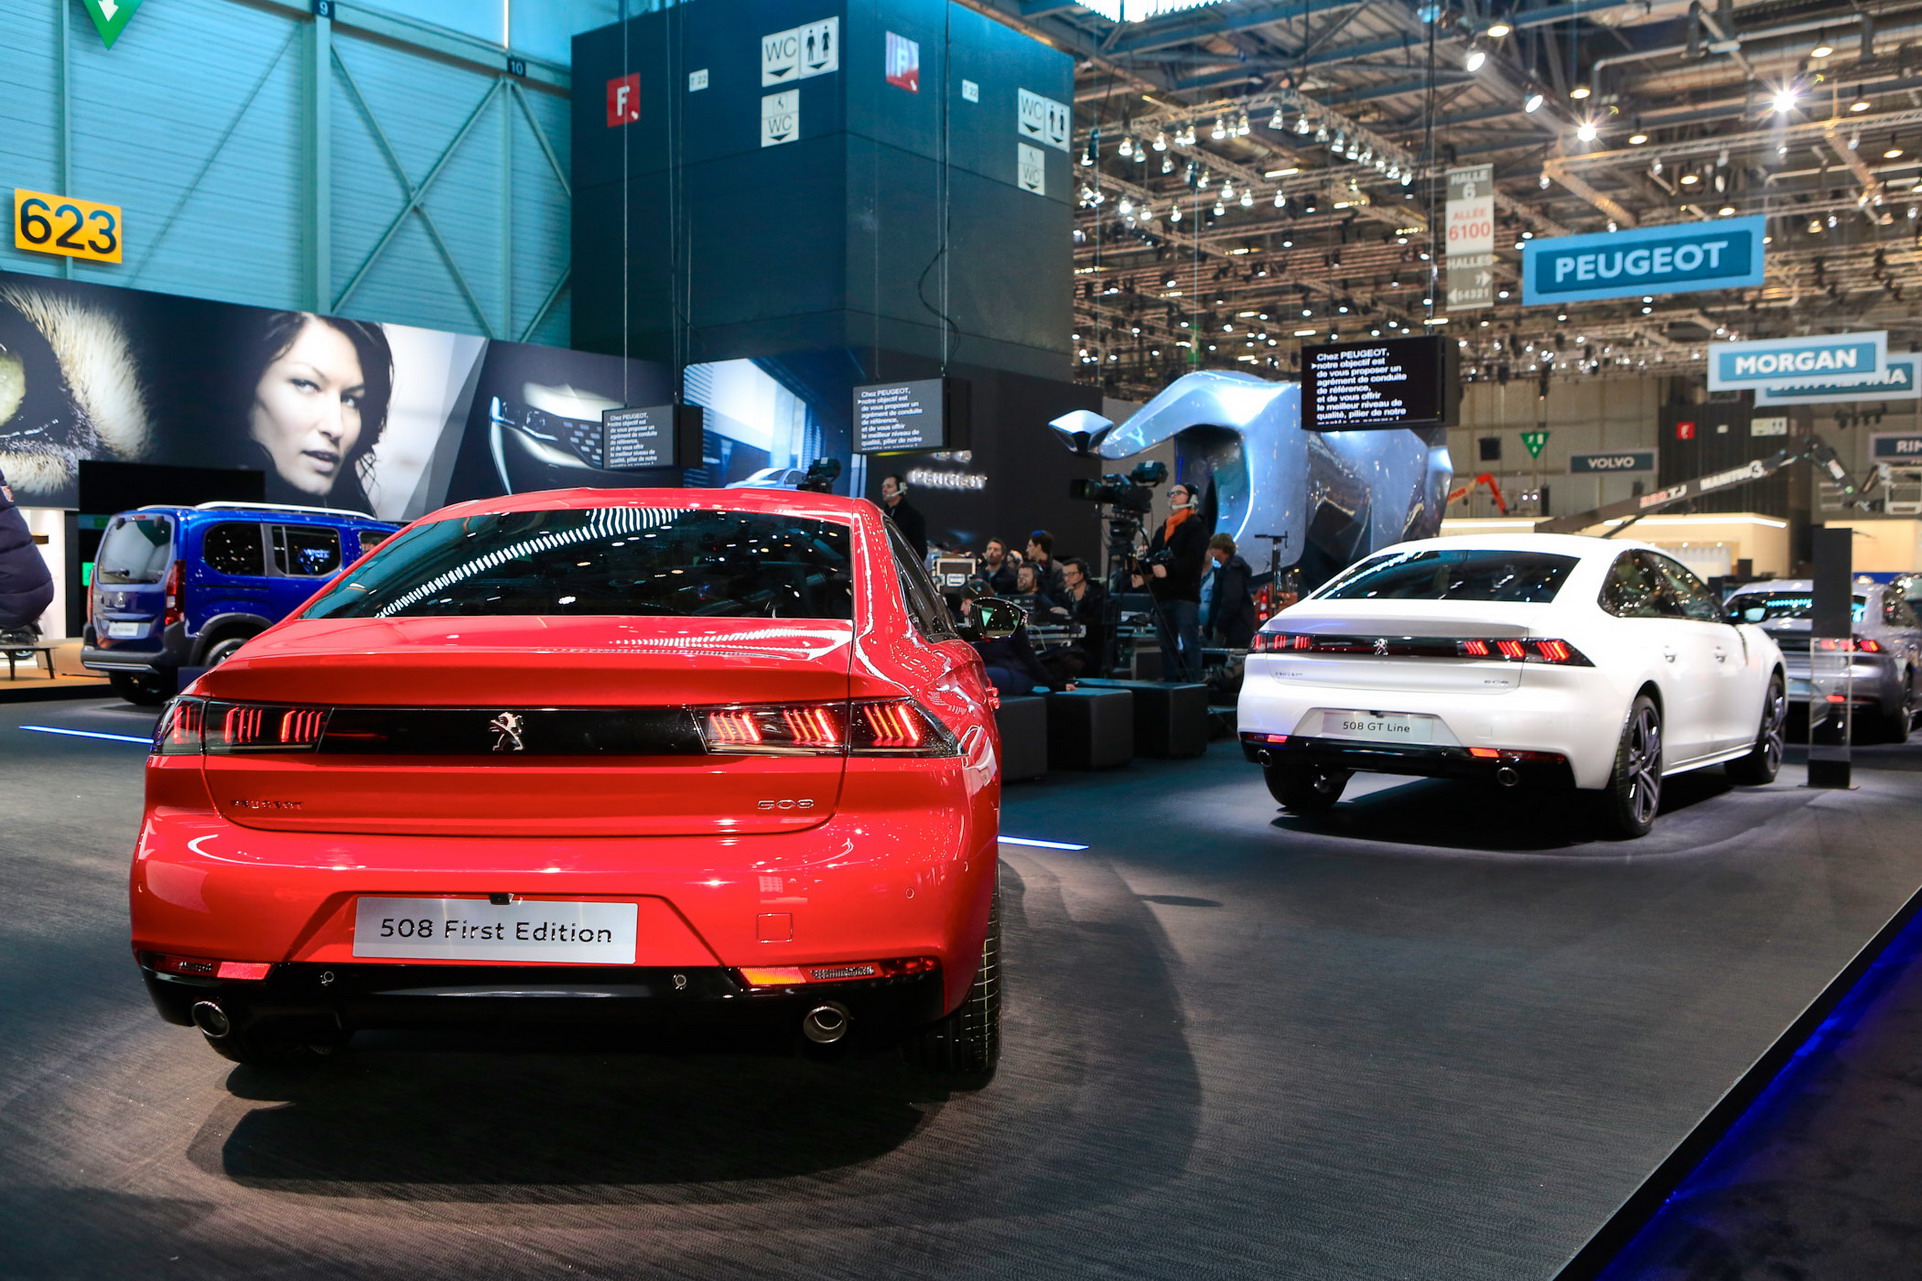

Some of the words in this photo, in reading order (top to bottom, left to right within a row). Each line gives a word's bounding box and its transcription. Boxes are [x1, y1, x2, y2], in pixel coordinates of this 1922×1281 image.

[320, 2, 328, 15] 9
[766, 37, 796, 62] WC
[511, 62, 523, 74] 10
[1021, 96, 1044, 120] WC
[768, 116, 792, 133] WC
[1023, 165, 1040, 183] WC
[1451, 170, 1488, 186] HALLE
[1463, 183, 1475, 200] 6
[21, 198, 117, 254] 623
[1449, 222, 1490, 241] 6100
[1447, 255, 1492, 270] HALLES
[1556, 241, 1728, 283] PEUGEOT
[1317, 353, 1339, 361] Chez
[1341, 348, 1389, 359] PEUGEOT,
[1317, 362, 1338, 370] notre
[1340, 358, 1370, 369] objectif
[1735, 349, 1857, 375] MORGAN
[1317, 370, 1327, 378] de
[1351, 366, 1388, 376] proposer
[1317, 377, 1356, 387] agrément
[1370, 373, 1407, 382] conduite
[1317, 387, 1327, 395] de
[1361, 392, 1381, 400] offrir
[885, 402, 910, 410] proposer
[1327, 402, 1359, 410] meilleur
[1349, 410, 1369, 419] pilier
[1588, 456, 1635, 468] VOLVO
[1342, 721, 1363, 731] 508
[1368, 722, 1384, 732] GT
[1387, 723, 1410, 733] Line
[758, 799, 814, 809] 508
[380, 918, 433, 938] 508
[444, 920, 504, 940] First
[516, 922, 612, 943] Edition
